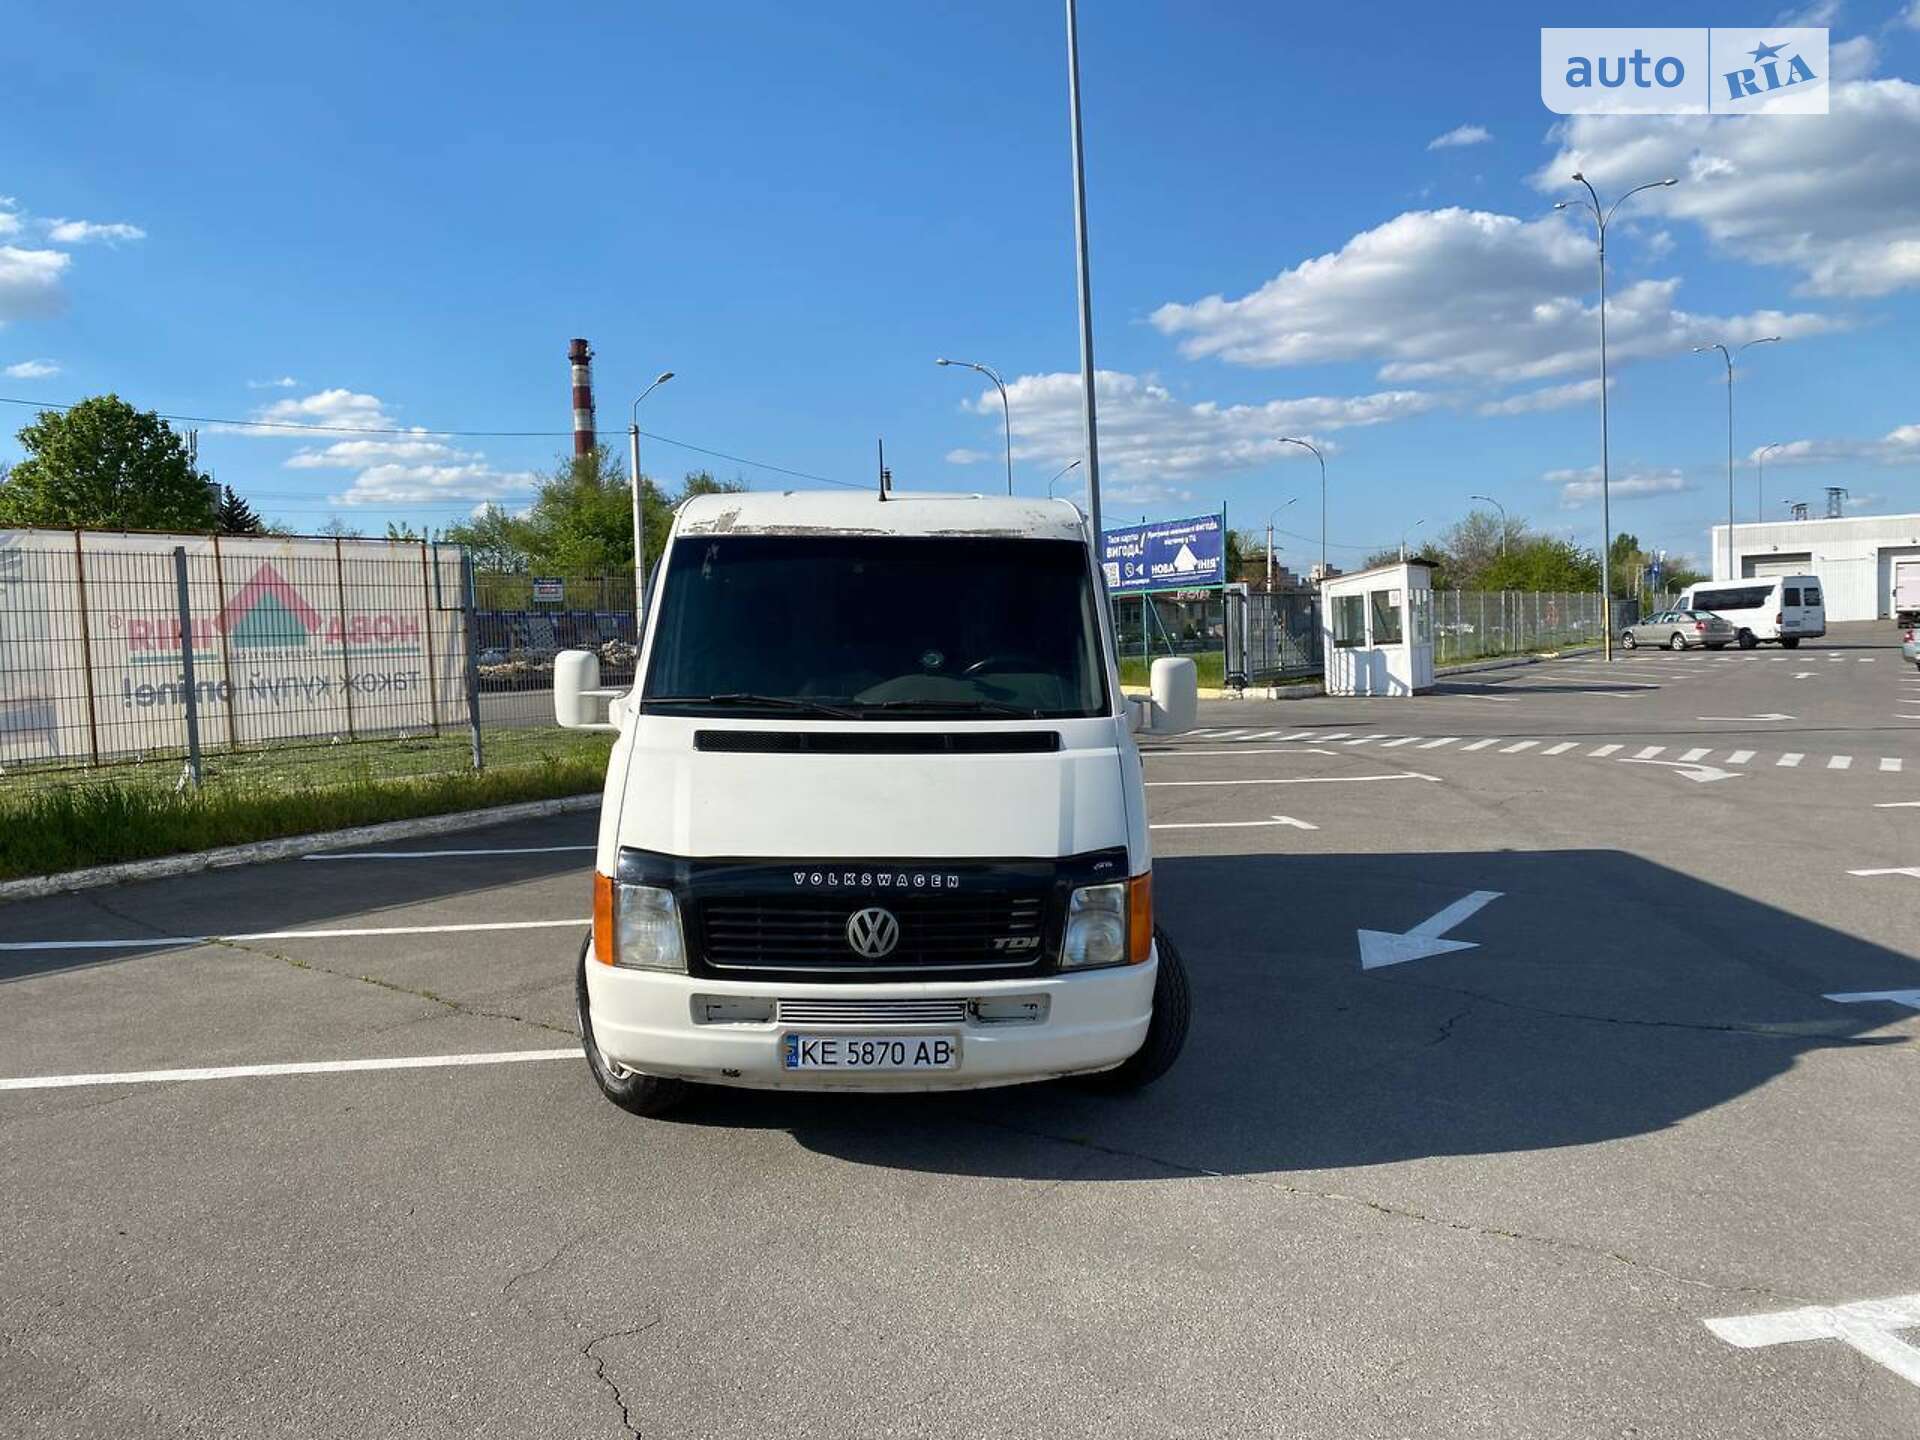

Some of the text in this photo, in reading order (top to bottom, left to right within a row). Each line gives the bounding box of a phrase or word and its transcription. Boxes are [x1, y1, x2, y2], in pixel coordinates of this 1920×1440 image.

[1151, 563, 1175, 575] НОВА
[794, 872, 959, 888] VOLKSWAGEN
[992, 936, 1040, 949] TDI
[801, 1040, 950, 1065] KE 5870 AB
